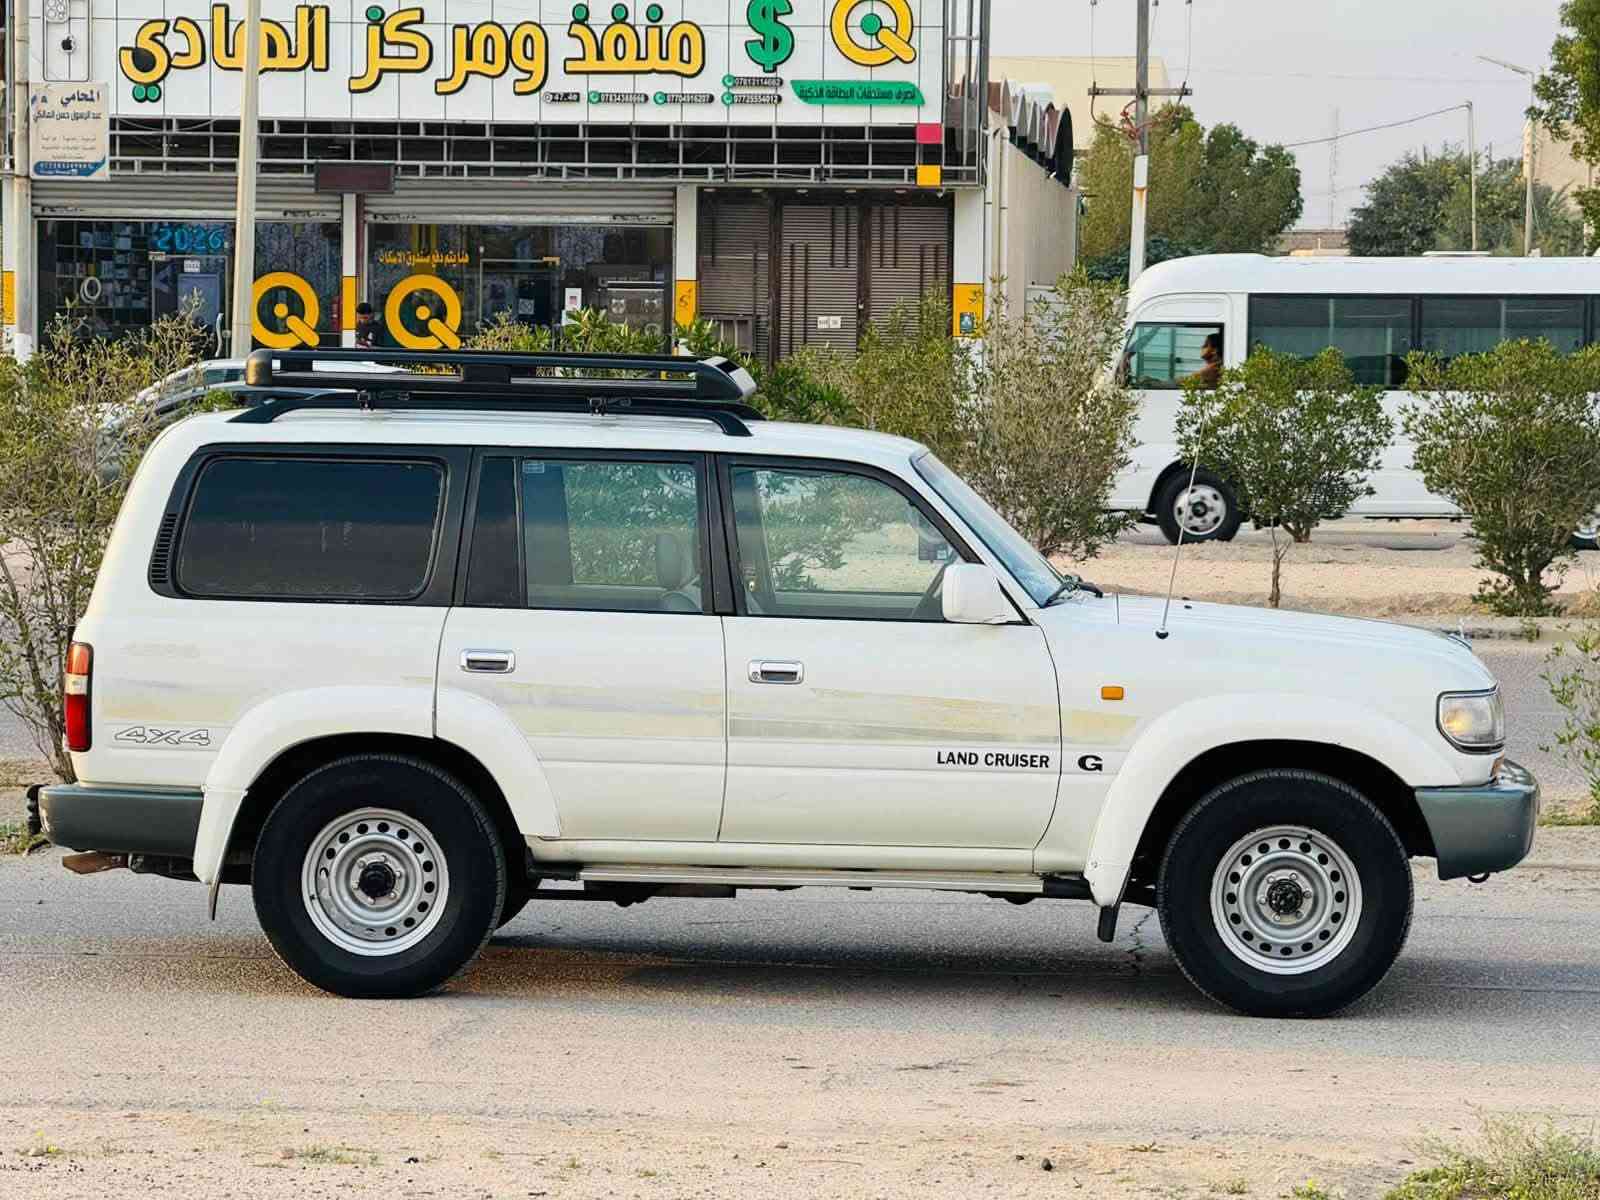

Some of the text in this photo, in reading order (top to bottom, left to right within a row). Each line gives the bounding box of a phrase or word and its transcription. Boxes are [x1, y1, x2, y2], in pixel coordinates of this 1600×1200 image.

[119, 3, 705, 102] منفذ ومركز الهادي
[157, 228, 225, 250] 2026
[936, 751, 1051, 769] LAND CRUISER
[1077, 755, 1104, 772] G
